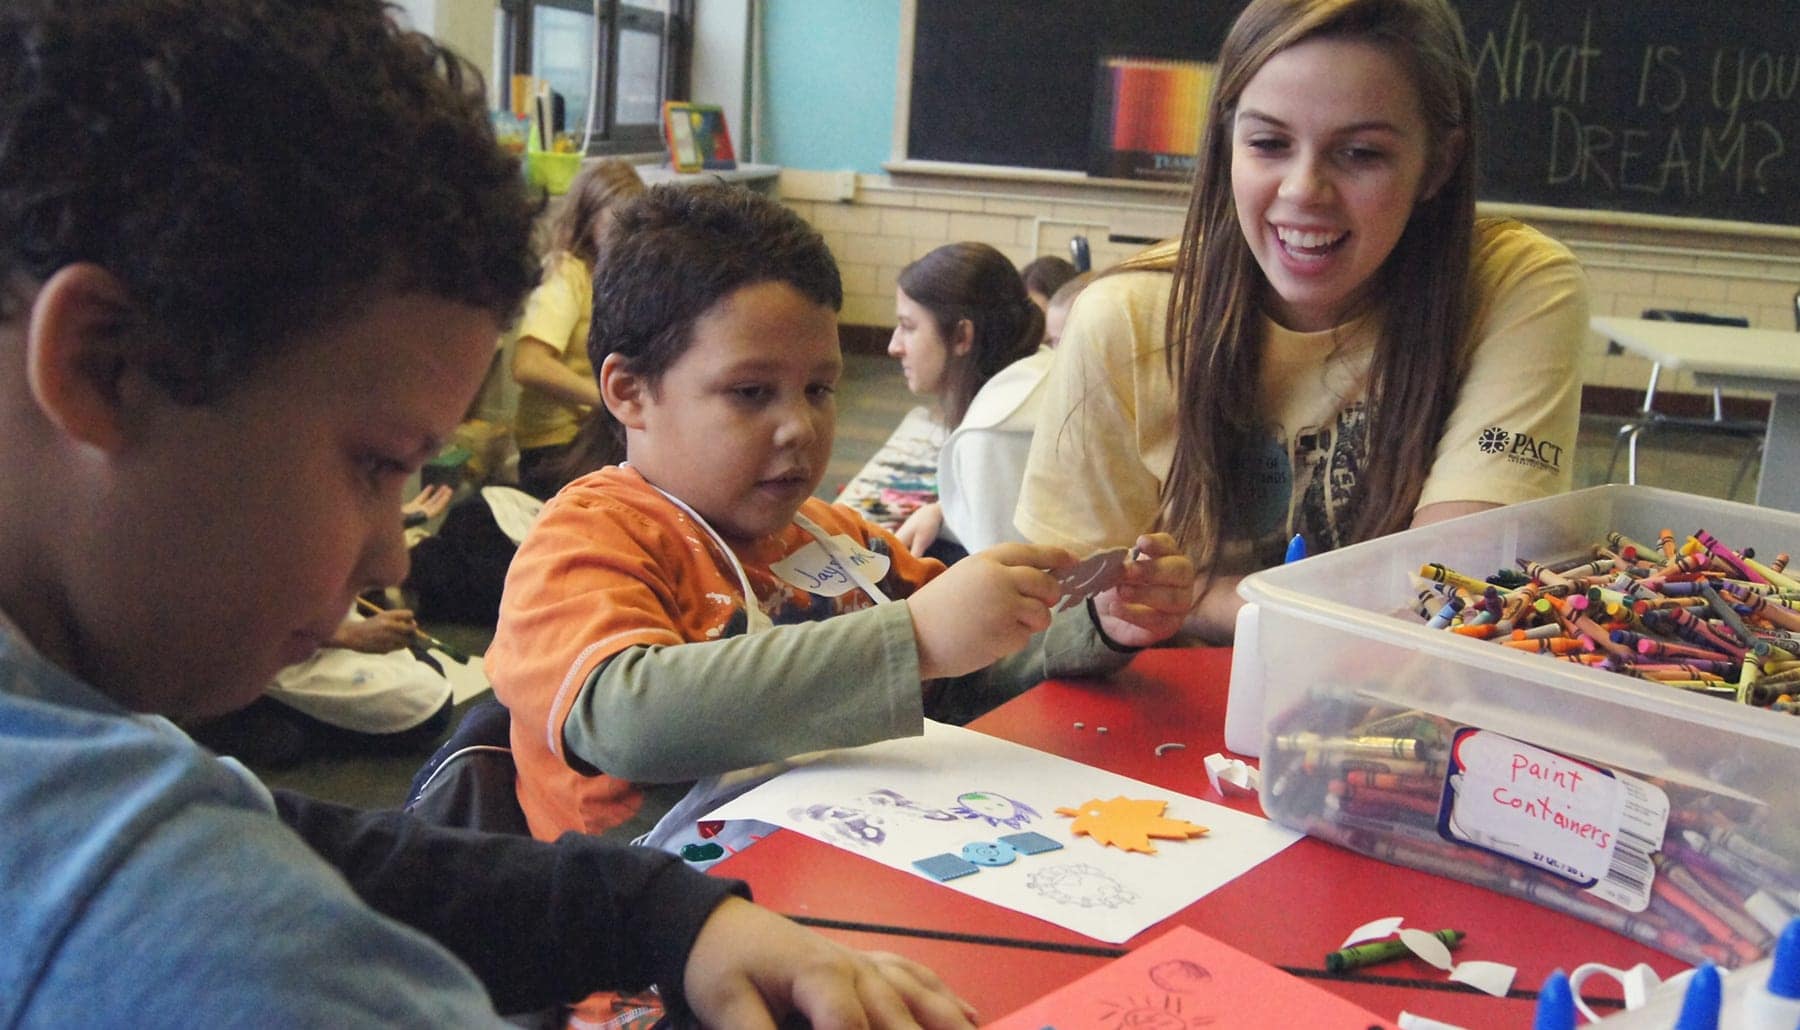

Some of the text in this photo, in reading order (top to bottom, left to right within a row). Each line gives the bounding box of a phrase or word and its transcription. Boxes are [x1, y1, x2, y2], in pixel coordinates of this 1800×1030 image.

[1470, 0, 1600, 105] What
[1547, 105, 1785, 194] DREAM?
[1510, 432, 1563, 466] PACT
